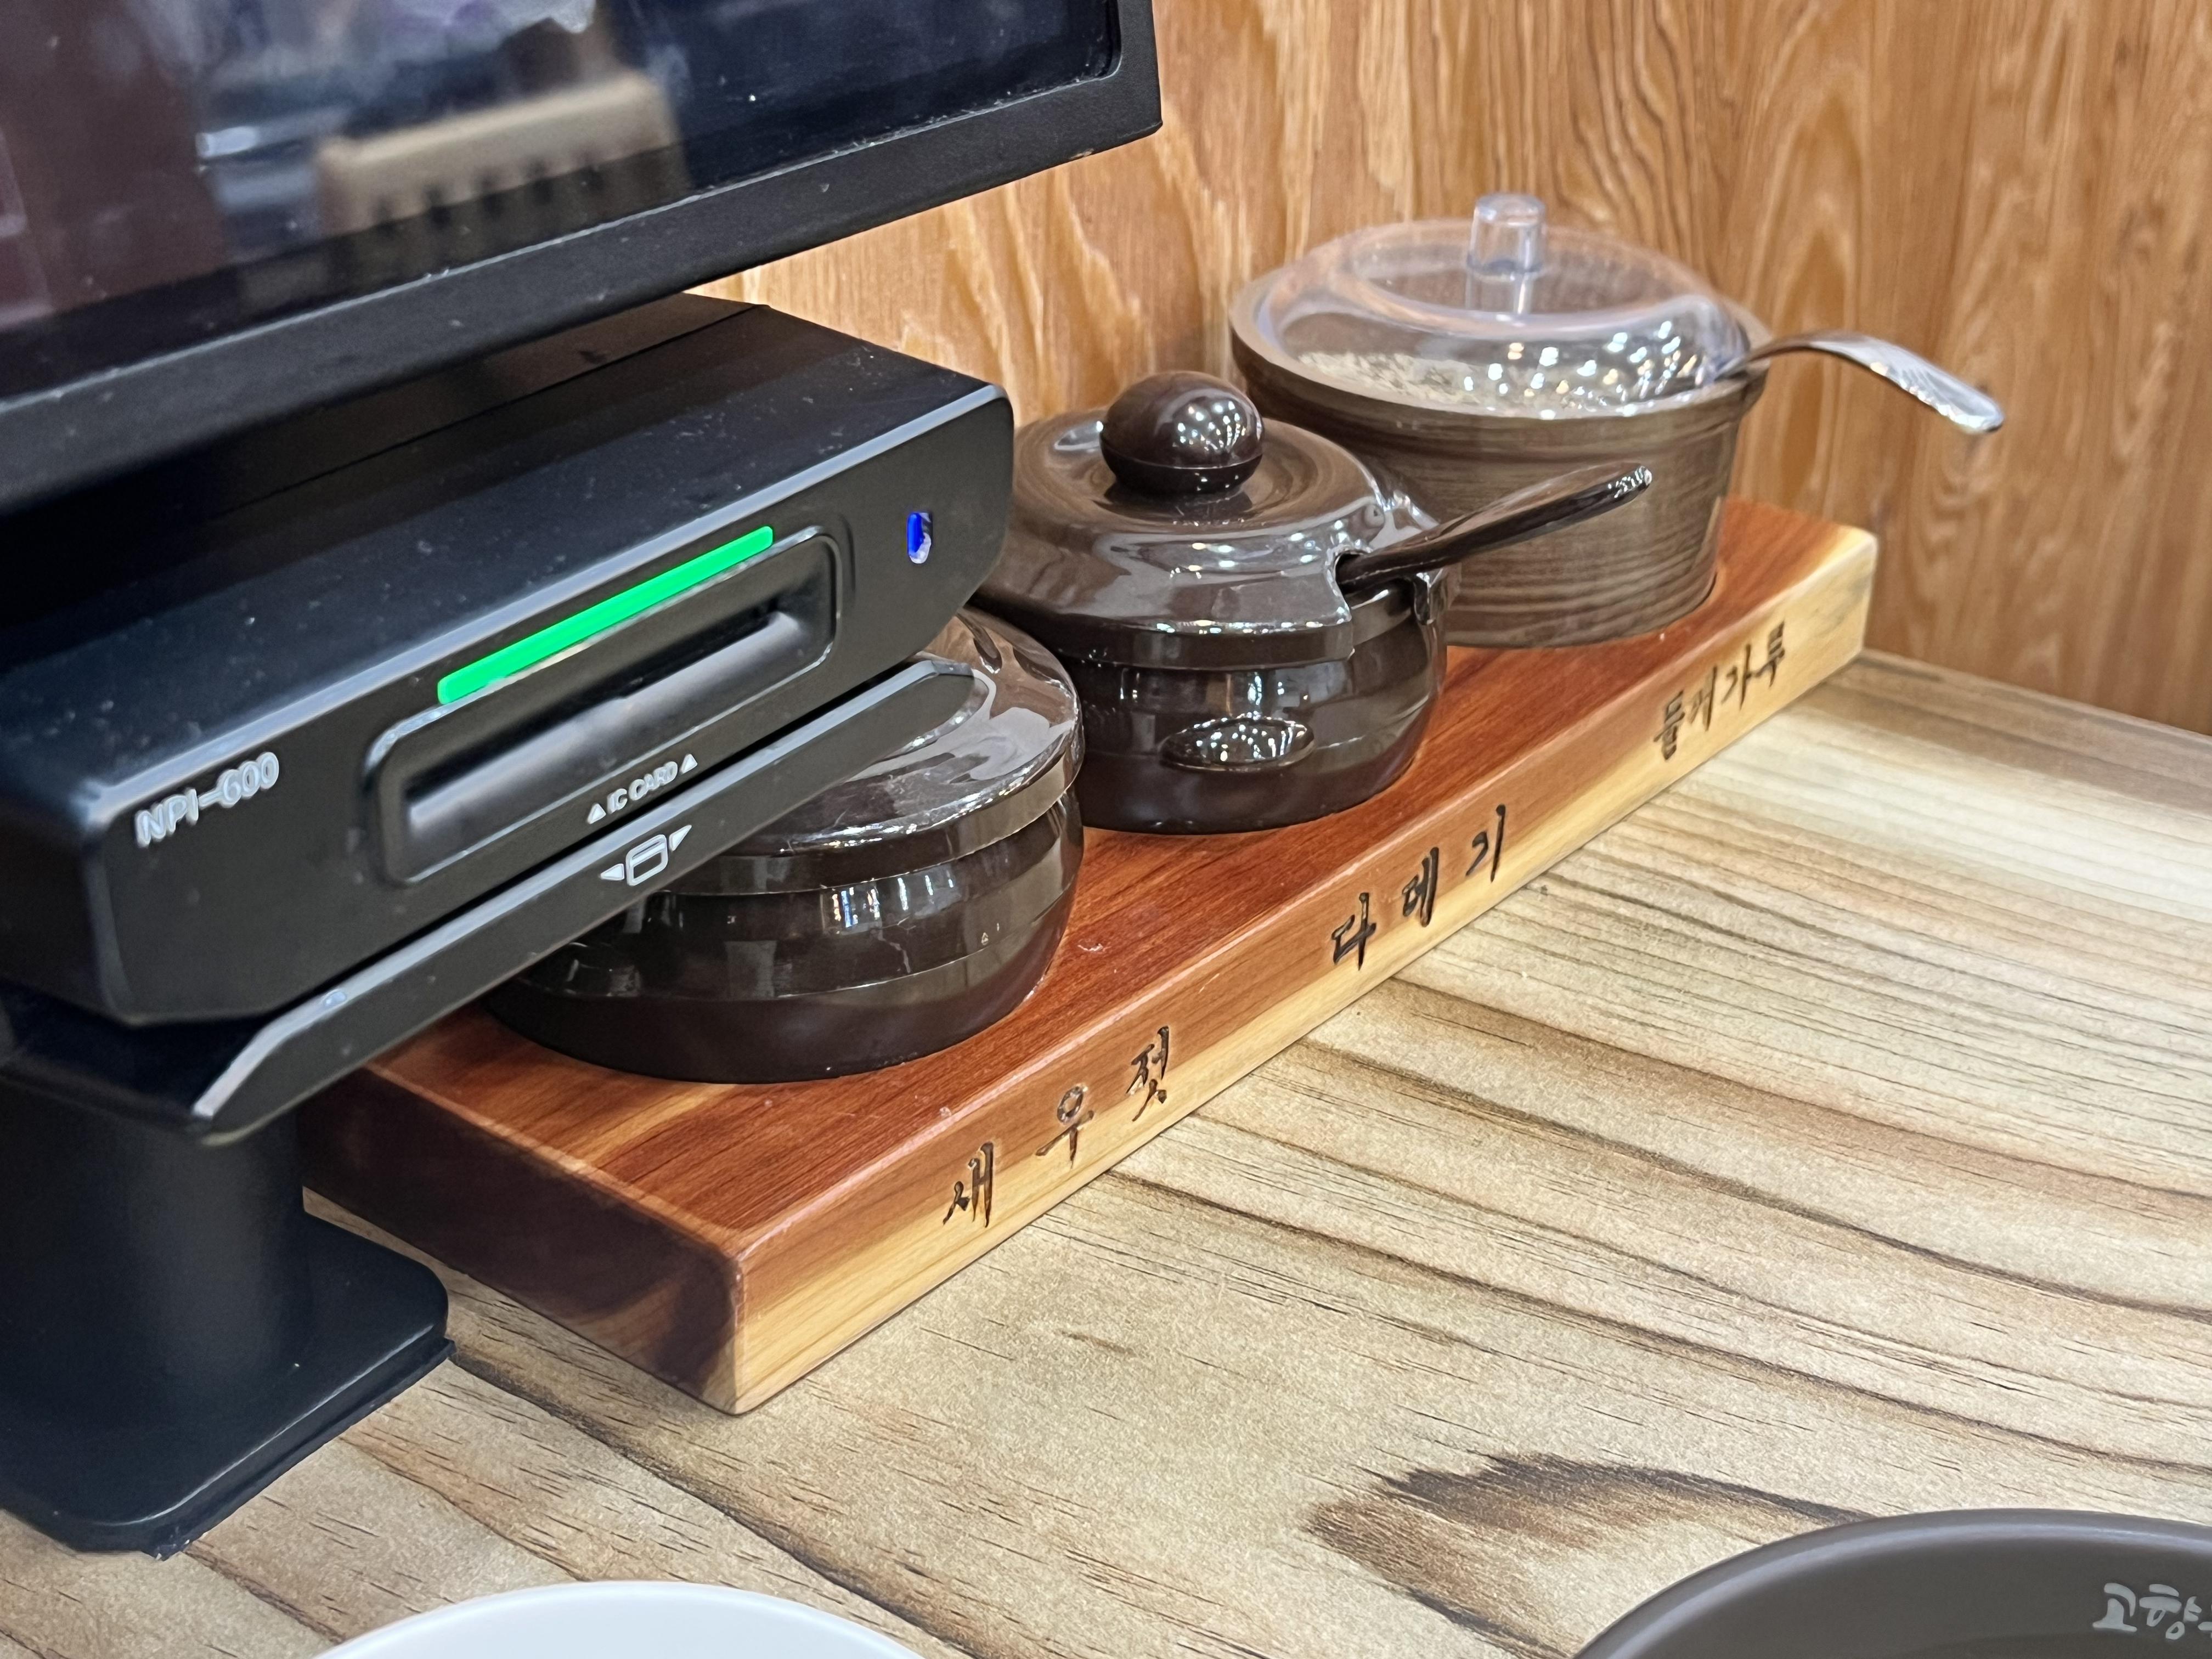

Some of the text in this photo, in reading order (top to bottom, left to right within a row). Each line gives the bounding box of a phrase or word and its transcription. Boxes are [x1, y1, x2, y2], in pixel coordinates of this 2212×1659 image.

[136, 752, 279, 848] NPI-600
[607, 761, 678, 814] IC CARD
[943, 1025, 1170, 1228] 새우젓
